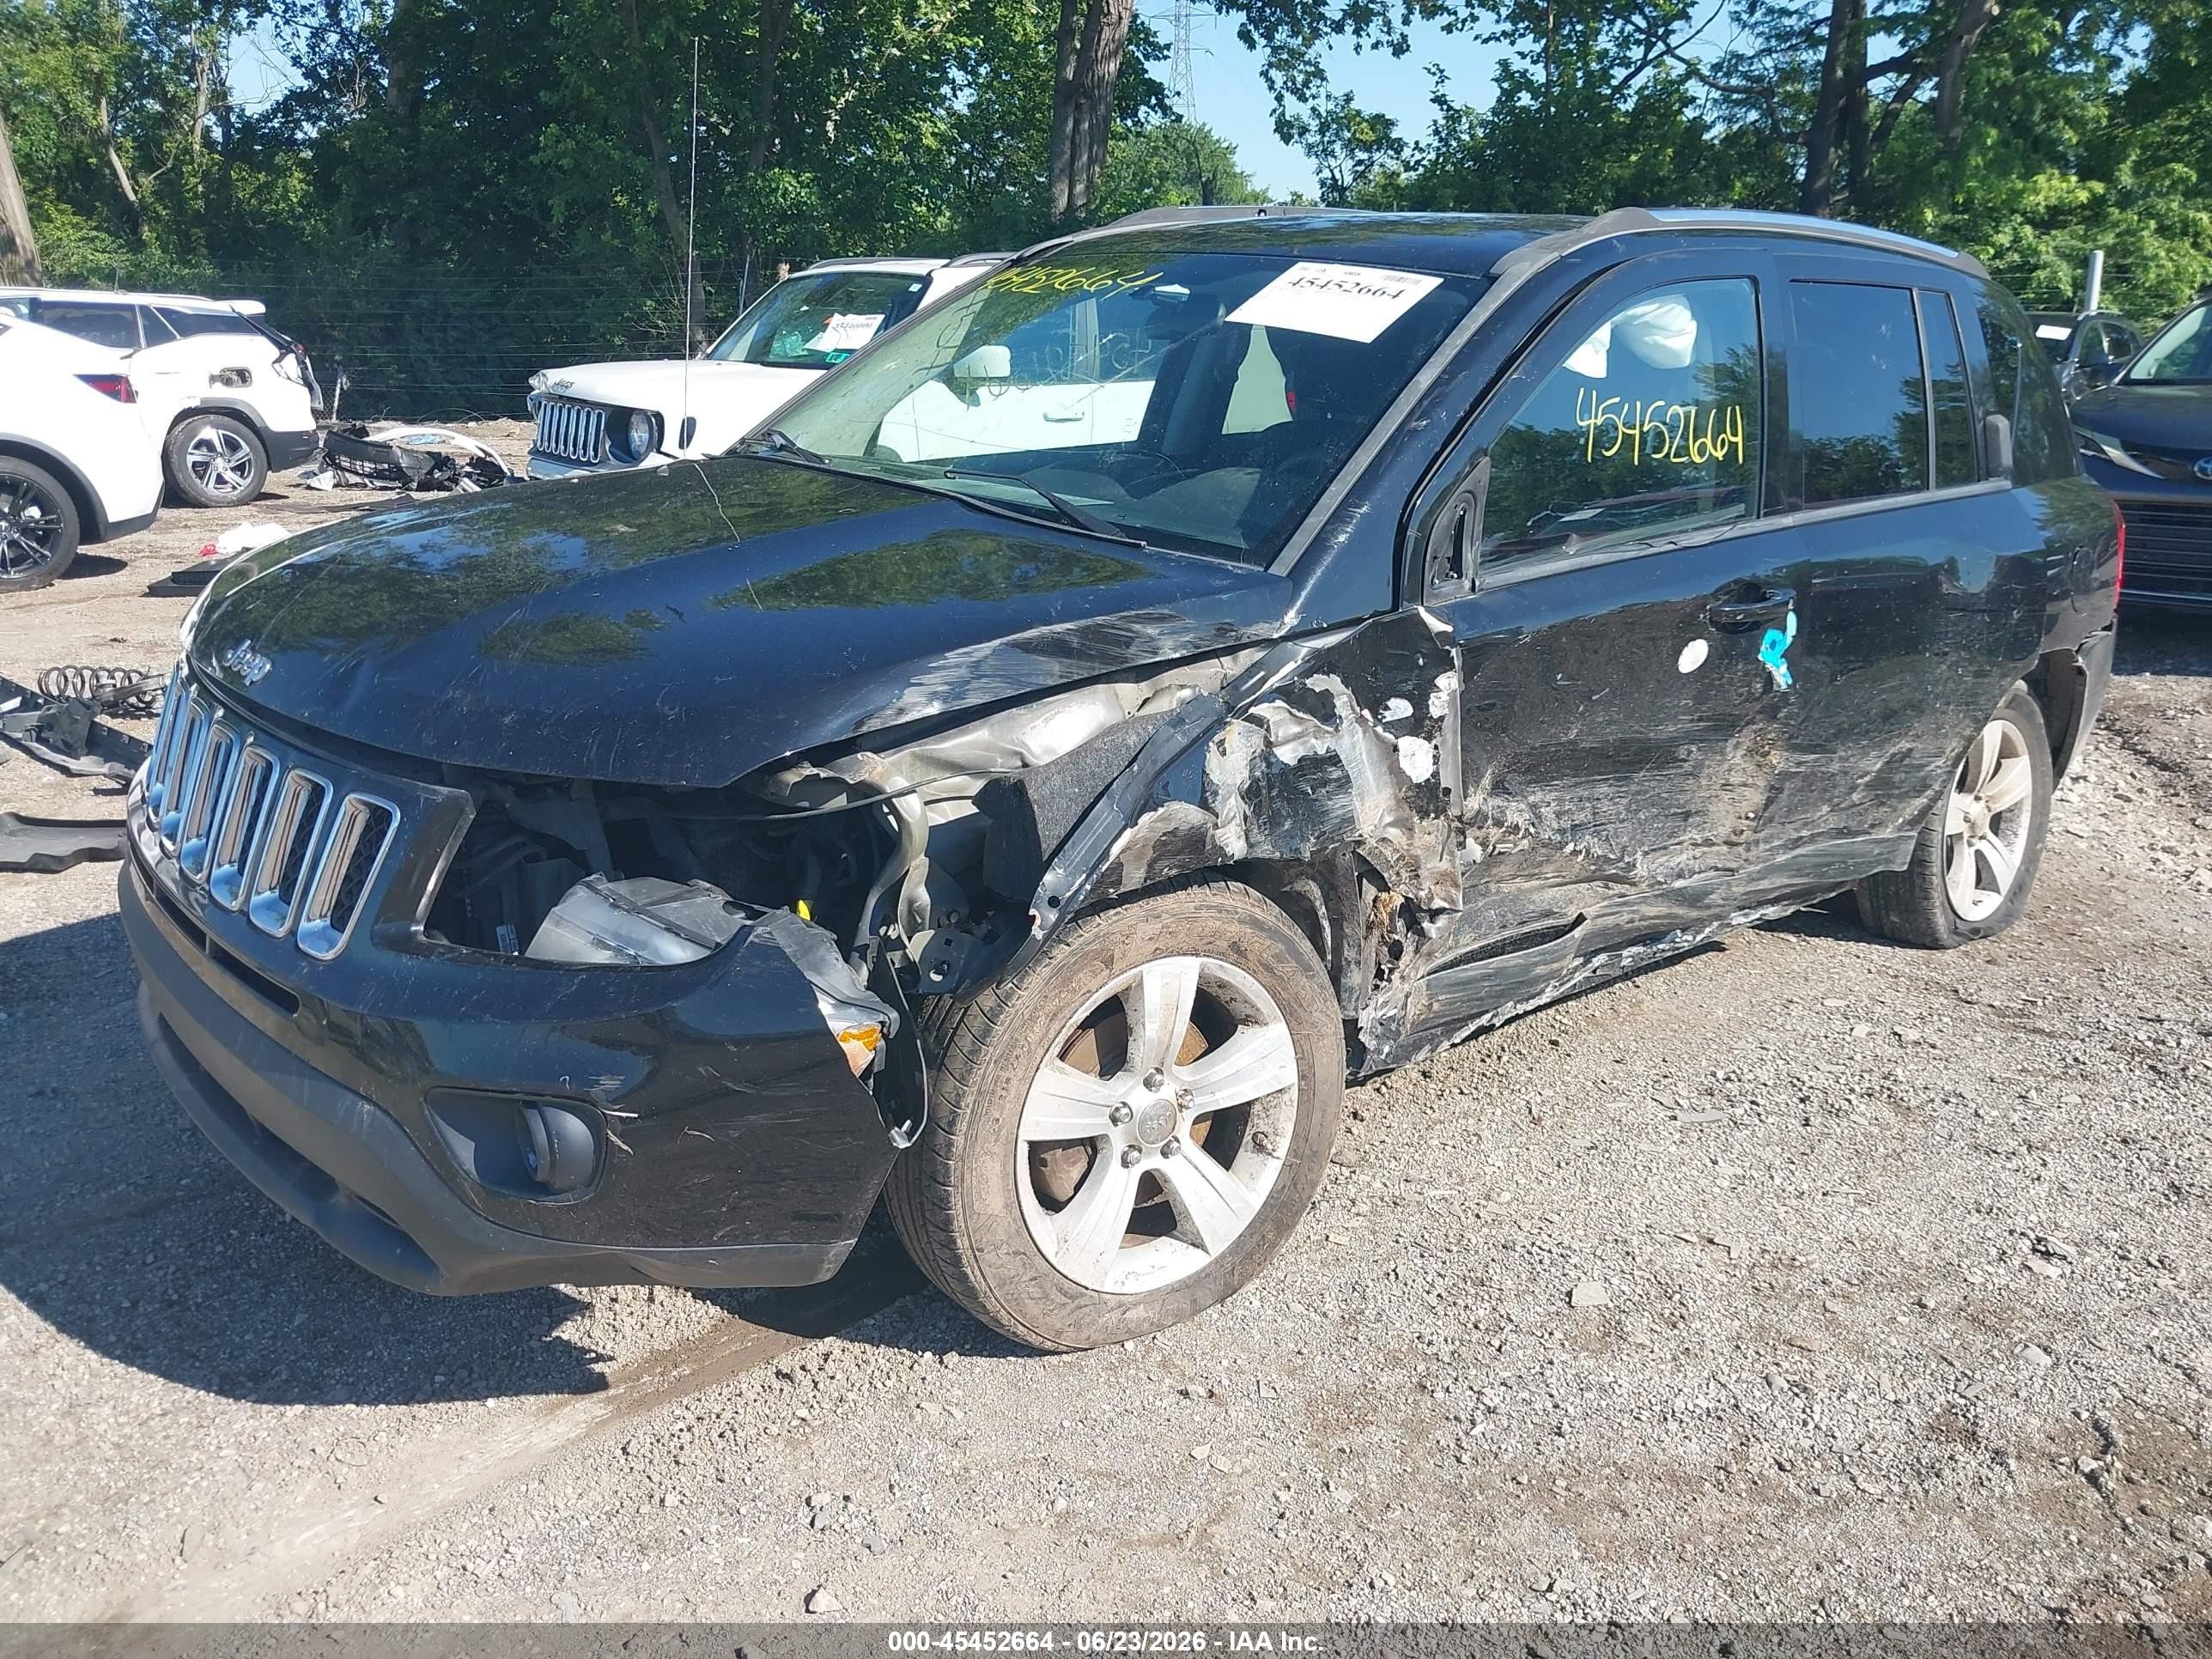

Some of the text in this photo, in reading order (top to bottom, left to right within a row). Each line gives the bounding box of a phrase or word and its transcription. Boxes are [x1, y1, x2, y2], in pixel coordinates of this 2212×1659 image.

[1287, 276, 1407, 301] 45452664
[1575, 386, 1745, 466] 45452664
[221, 638, 273, 687] Jeep
